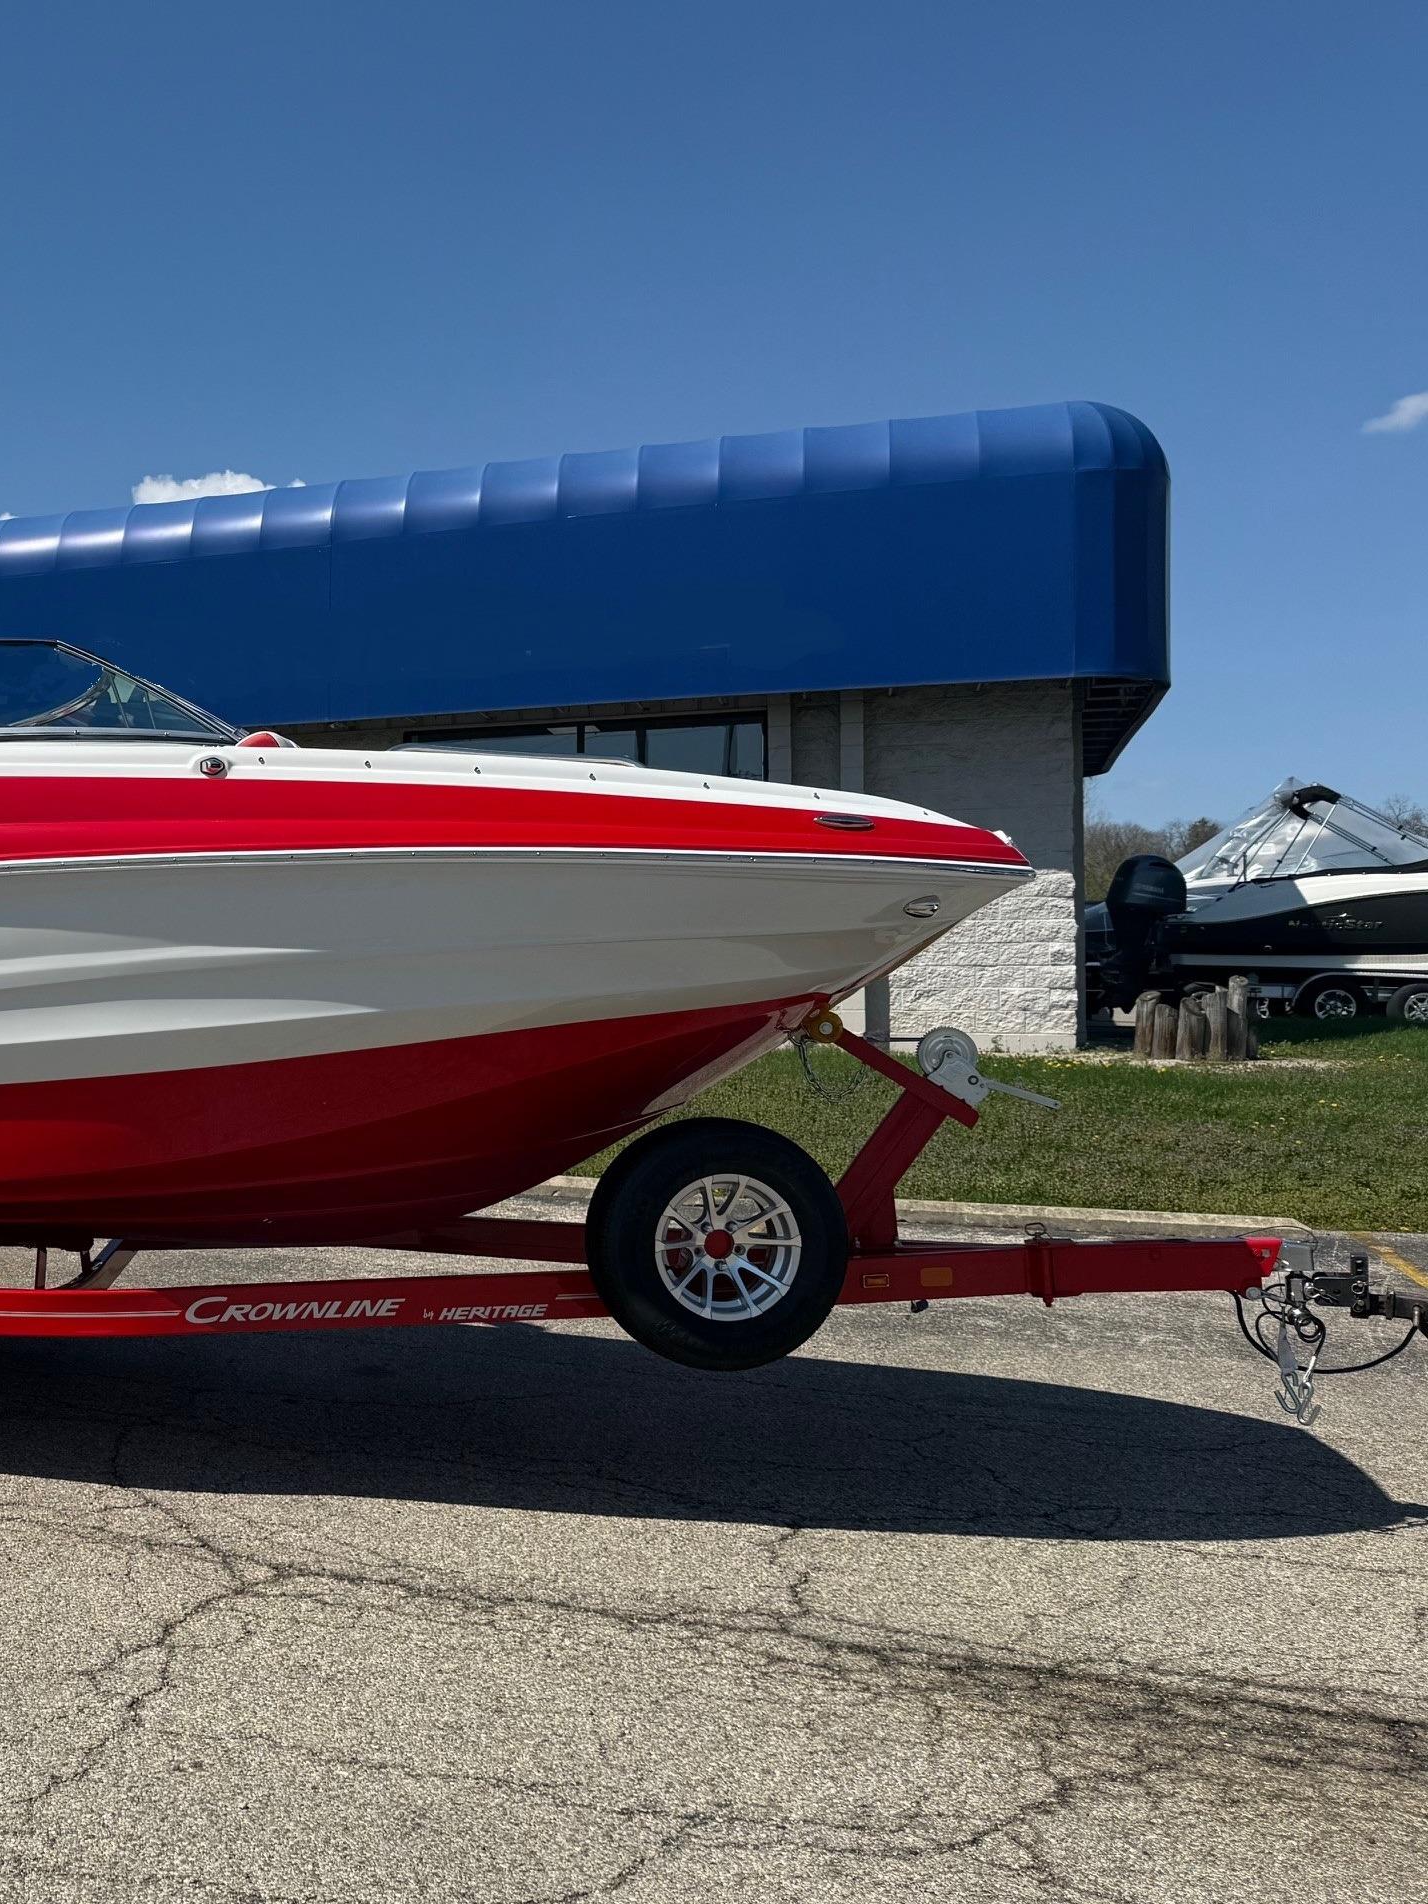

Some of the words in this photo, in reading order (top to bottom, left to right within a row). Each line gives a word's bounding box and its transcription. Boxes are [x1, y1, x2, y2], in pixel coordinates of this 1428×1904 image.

[184, 1296, 406, 1324] CROWNLINE
[422, 1308, 434, 1320] by
[438, 1303, 549, 1320] HERITAGE
